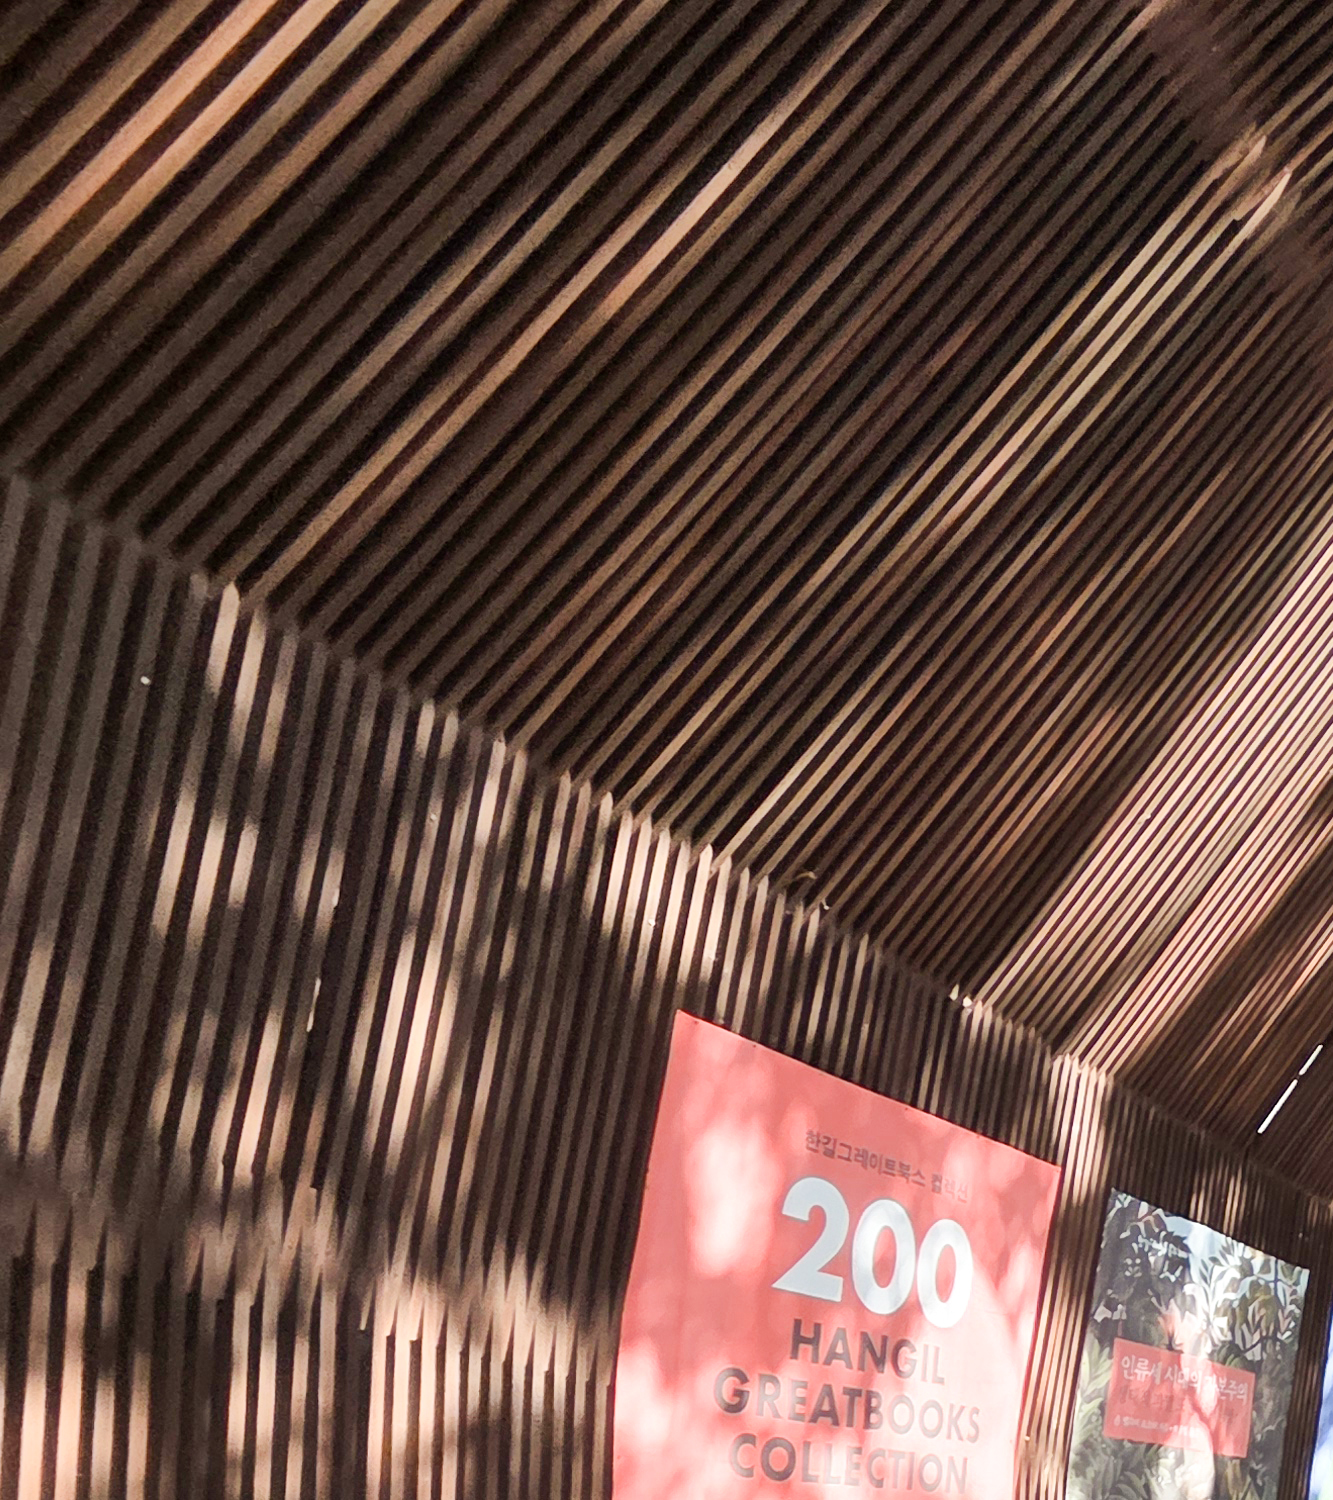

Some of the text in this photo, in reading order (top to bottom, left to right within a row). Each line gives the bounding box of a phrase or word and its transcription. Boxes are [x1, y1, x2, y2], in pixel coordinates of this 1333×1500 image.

[805, 1129, 926, 1187] 한길그레이트북스
[771, 1176, 974, 1328] 200
[789, 1317, 946, 1386] HANGIL
[713, 1366, 981, 1444] GREATBOOKS
[729, 1432, 969, 1495] COLLECTION
